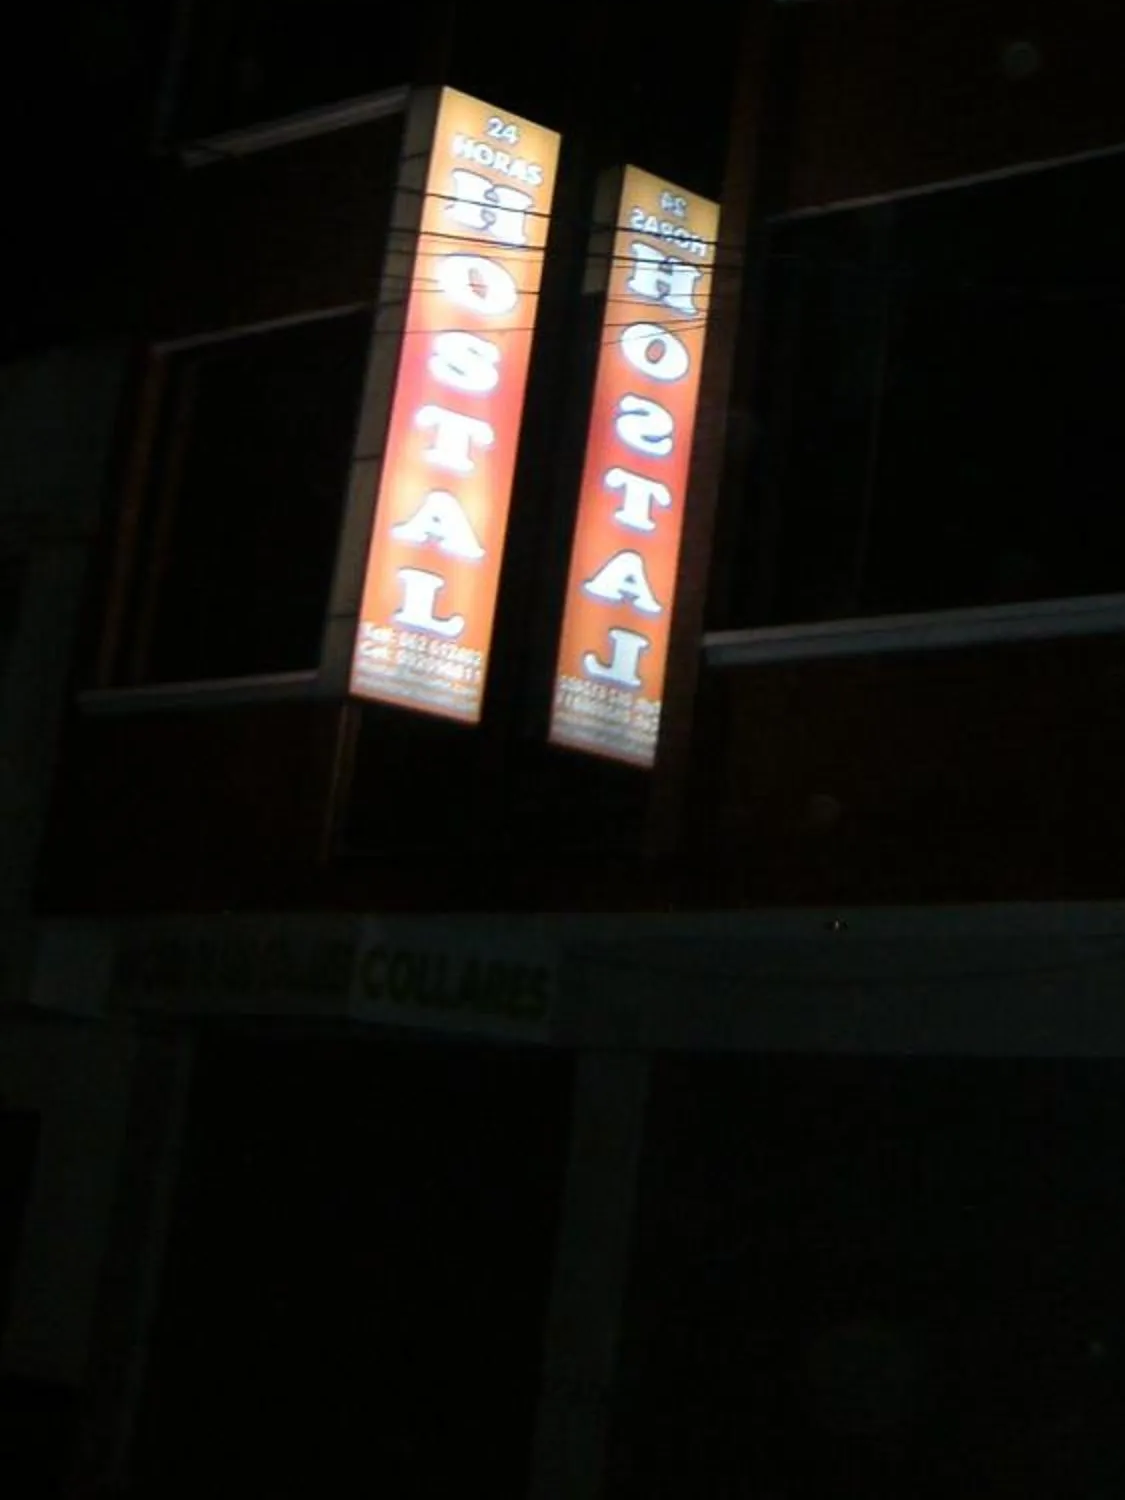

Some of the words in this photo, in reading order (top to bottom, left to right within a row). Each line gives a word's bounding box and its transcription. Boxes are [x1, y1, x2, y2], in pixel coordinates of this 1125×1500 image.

[487, 116, 520, 145] 24
[452, 132, 544, 187] HORAS
[390, 167, 536, 638] HOSTAL
